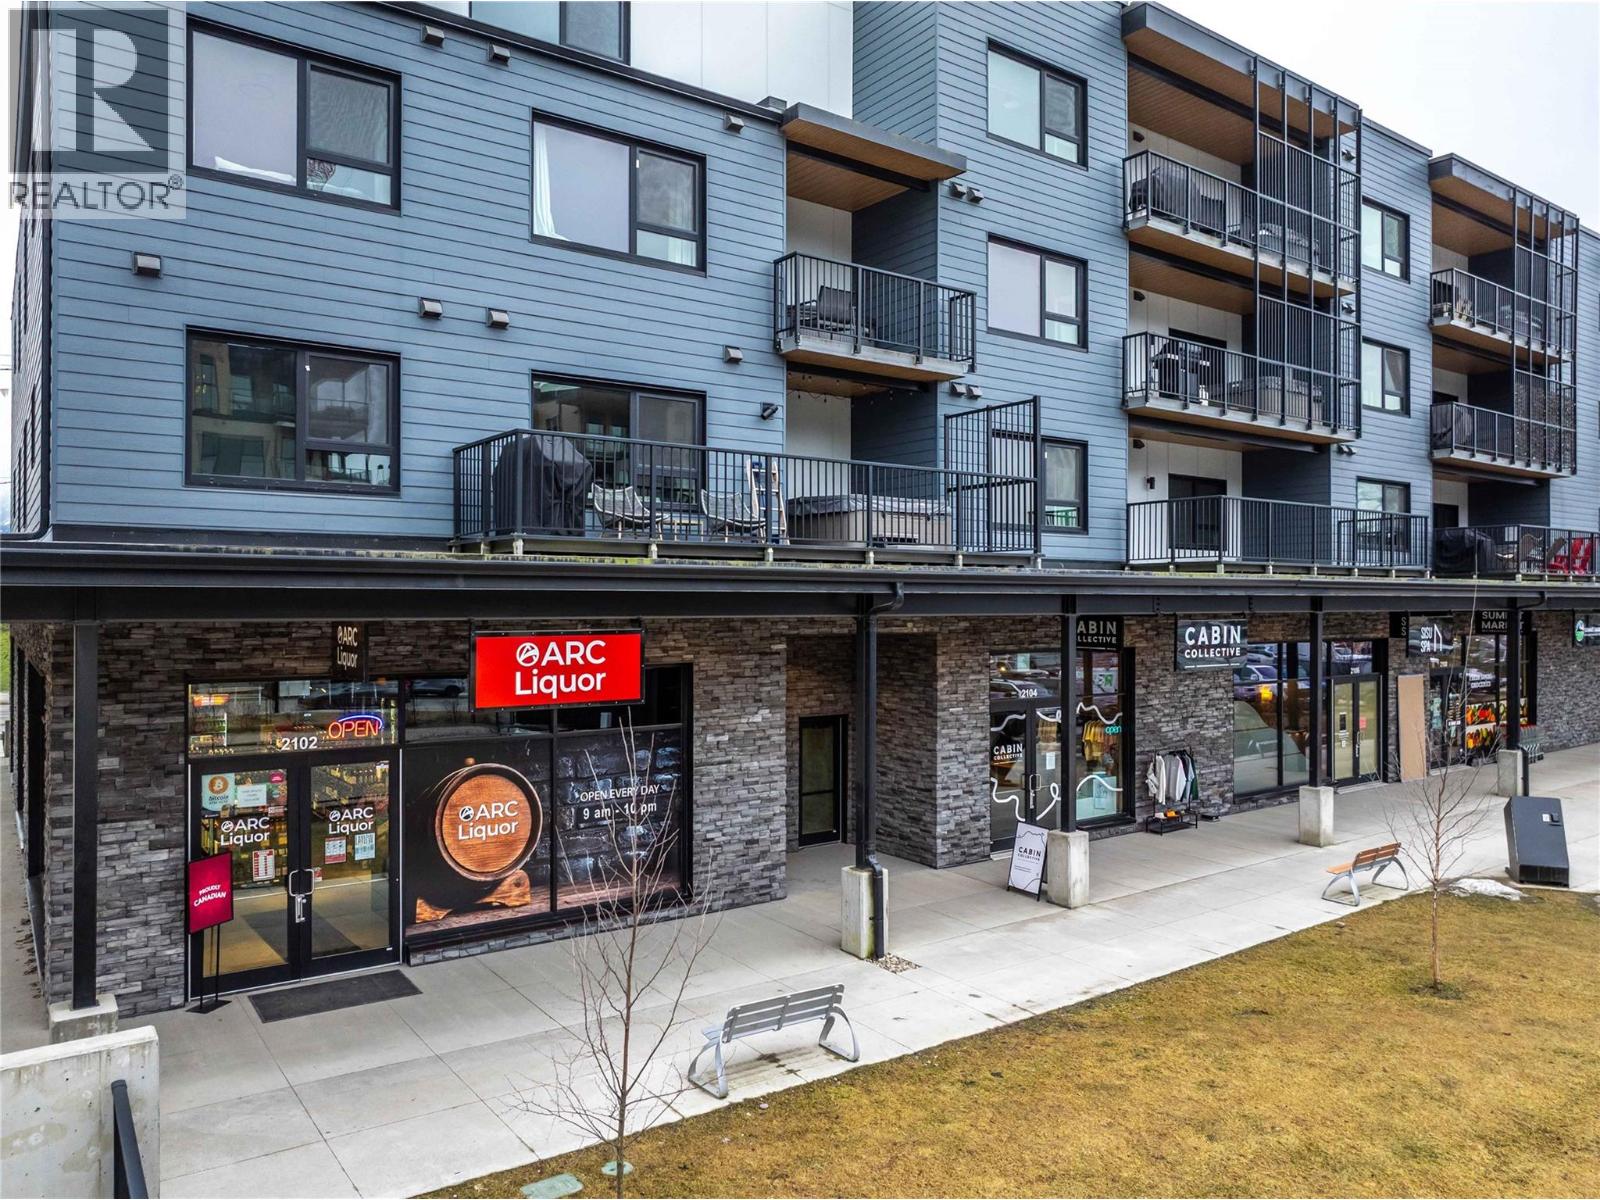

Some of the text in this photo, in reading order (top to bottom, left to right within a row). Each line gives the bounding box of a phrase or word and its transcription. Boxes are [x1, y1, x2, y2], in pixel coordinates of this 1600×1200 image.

[1077, 620, 1117, 635] ABIN
[1184, 625, 1241, 646] CABIN
[342, 625, 358, 647] ARC
[1077, 635, 1117, 644] LLECTIVE
[337, 646, 358, 671] Liquor
[541, 640, 607, 667] ARC
[1184, 647, 1241, 659] COLLECTIVE
[515, 668, 607, 700] Liquor
[1020, 689, 1038, 698] 2104
[328, 720, 379, 739] OPEN
[281, 736, 318, 751] 2102
[993, 743, 1023, 755] CABIN
[580, 784, 660, 802] OPEN EVERY DAY
[342, 807, 374, 820] ARC
[475, 800, 518, 820] ARC
[582, 808, 590, 820] 9
[594, 808, 611, 818] am
[624, 802, 636, 815] 10
[641, 802, 657, 815] pm
[234, 817, 270, 832] ARC
[328, 819, 374, 835] Liquor
[458, 821, 519, 841] Liquor
[220, 831, 270, 847] Liquor
[1018, 846, 1041, 857] CABIN
[199, 884, 221, 895] PROUDLY
[194, 891, 227, 907] CANADIAN
